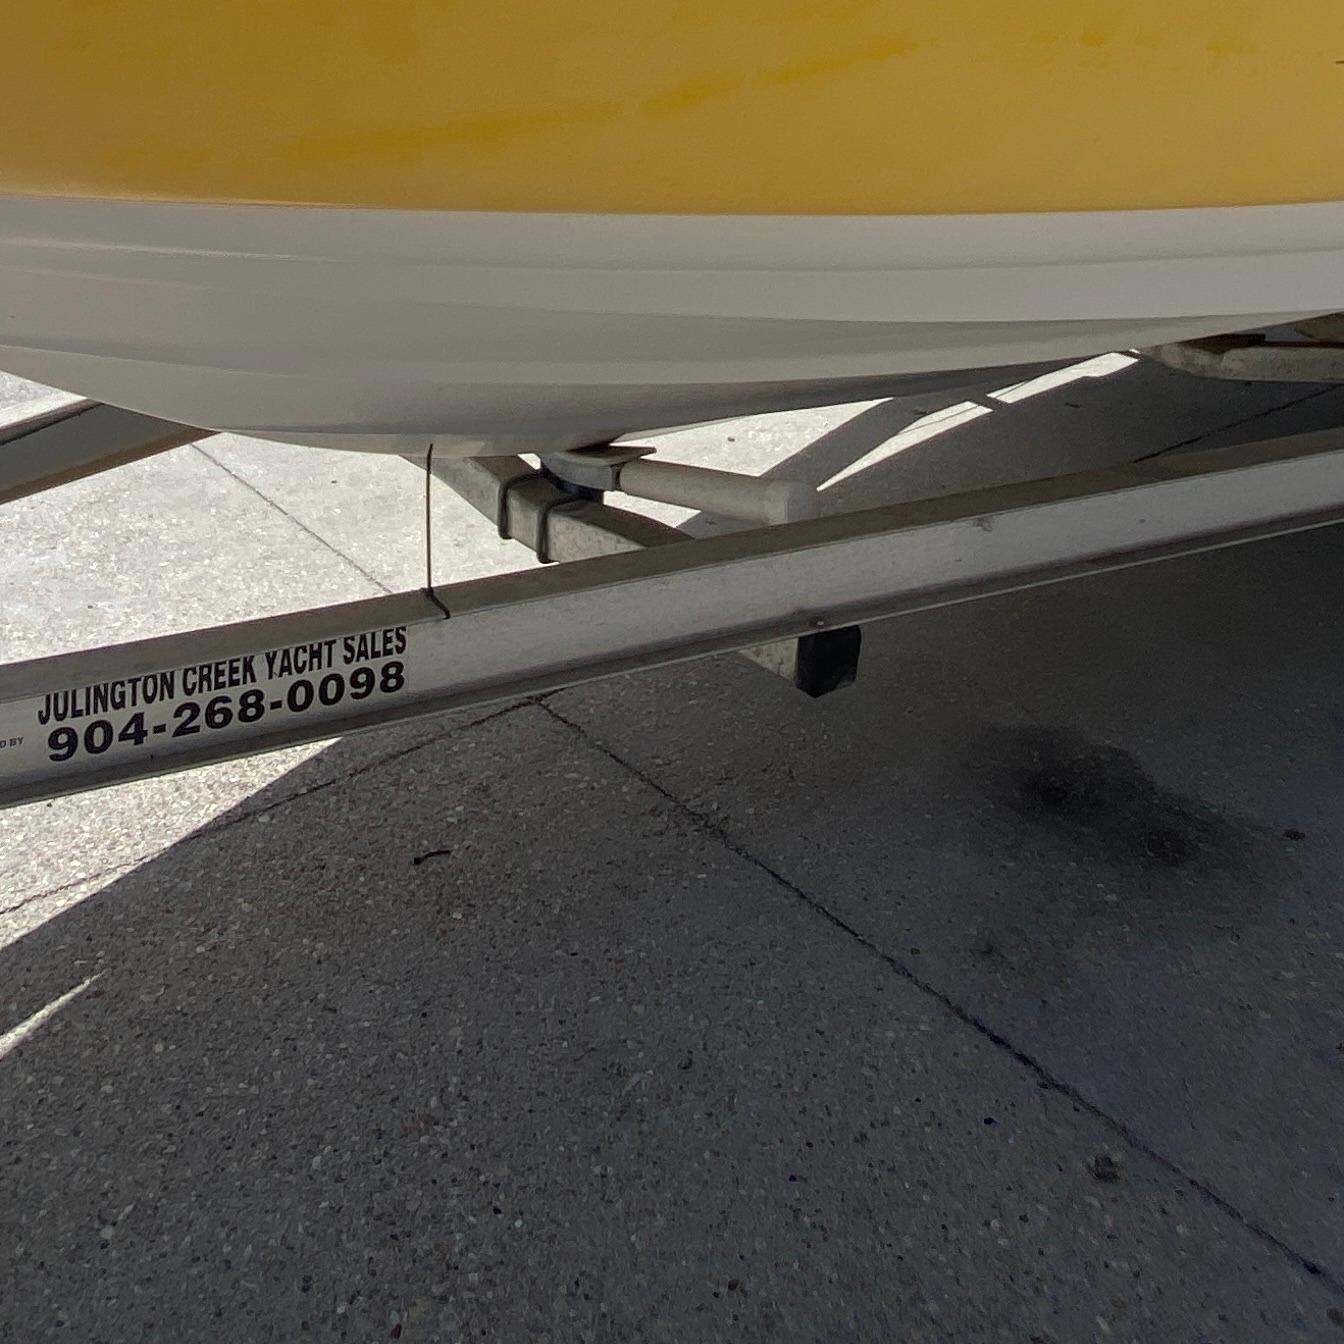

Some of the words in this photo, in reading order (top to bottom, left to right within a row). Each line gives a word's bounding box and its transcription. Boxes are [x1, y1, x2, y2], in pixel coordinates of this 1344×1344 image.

[38, 670, 175, 726] JULINGTON
[182, 655, 257, 697] CREEK
[264, 639, 337, 680] YACHT
[342, 625, 407, 666] SALES
[47, 661, 405, 762] 904-268-0098
[9, 736, 24, 747] BY
